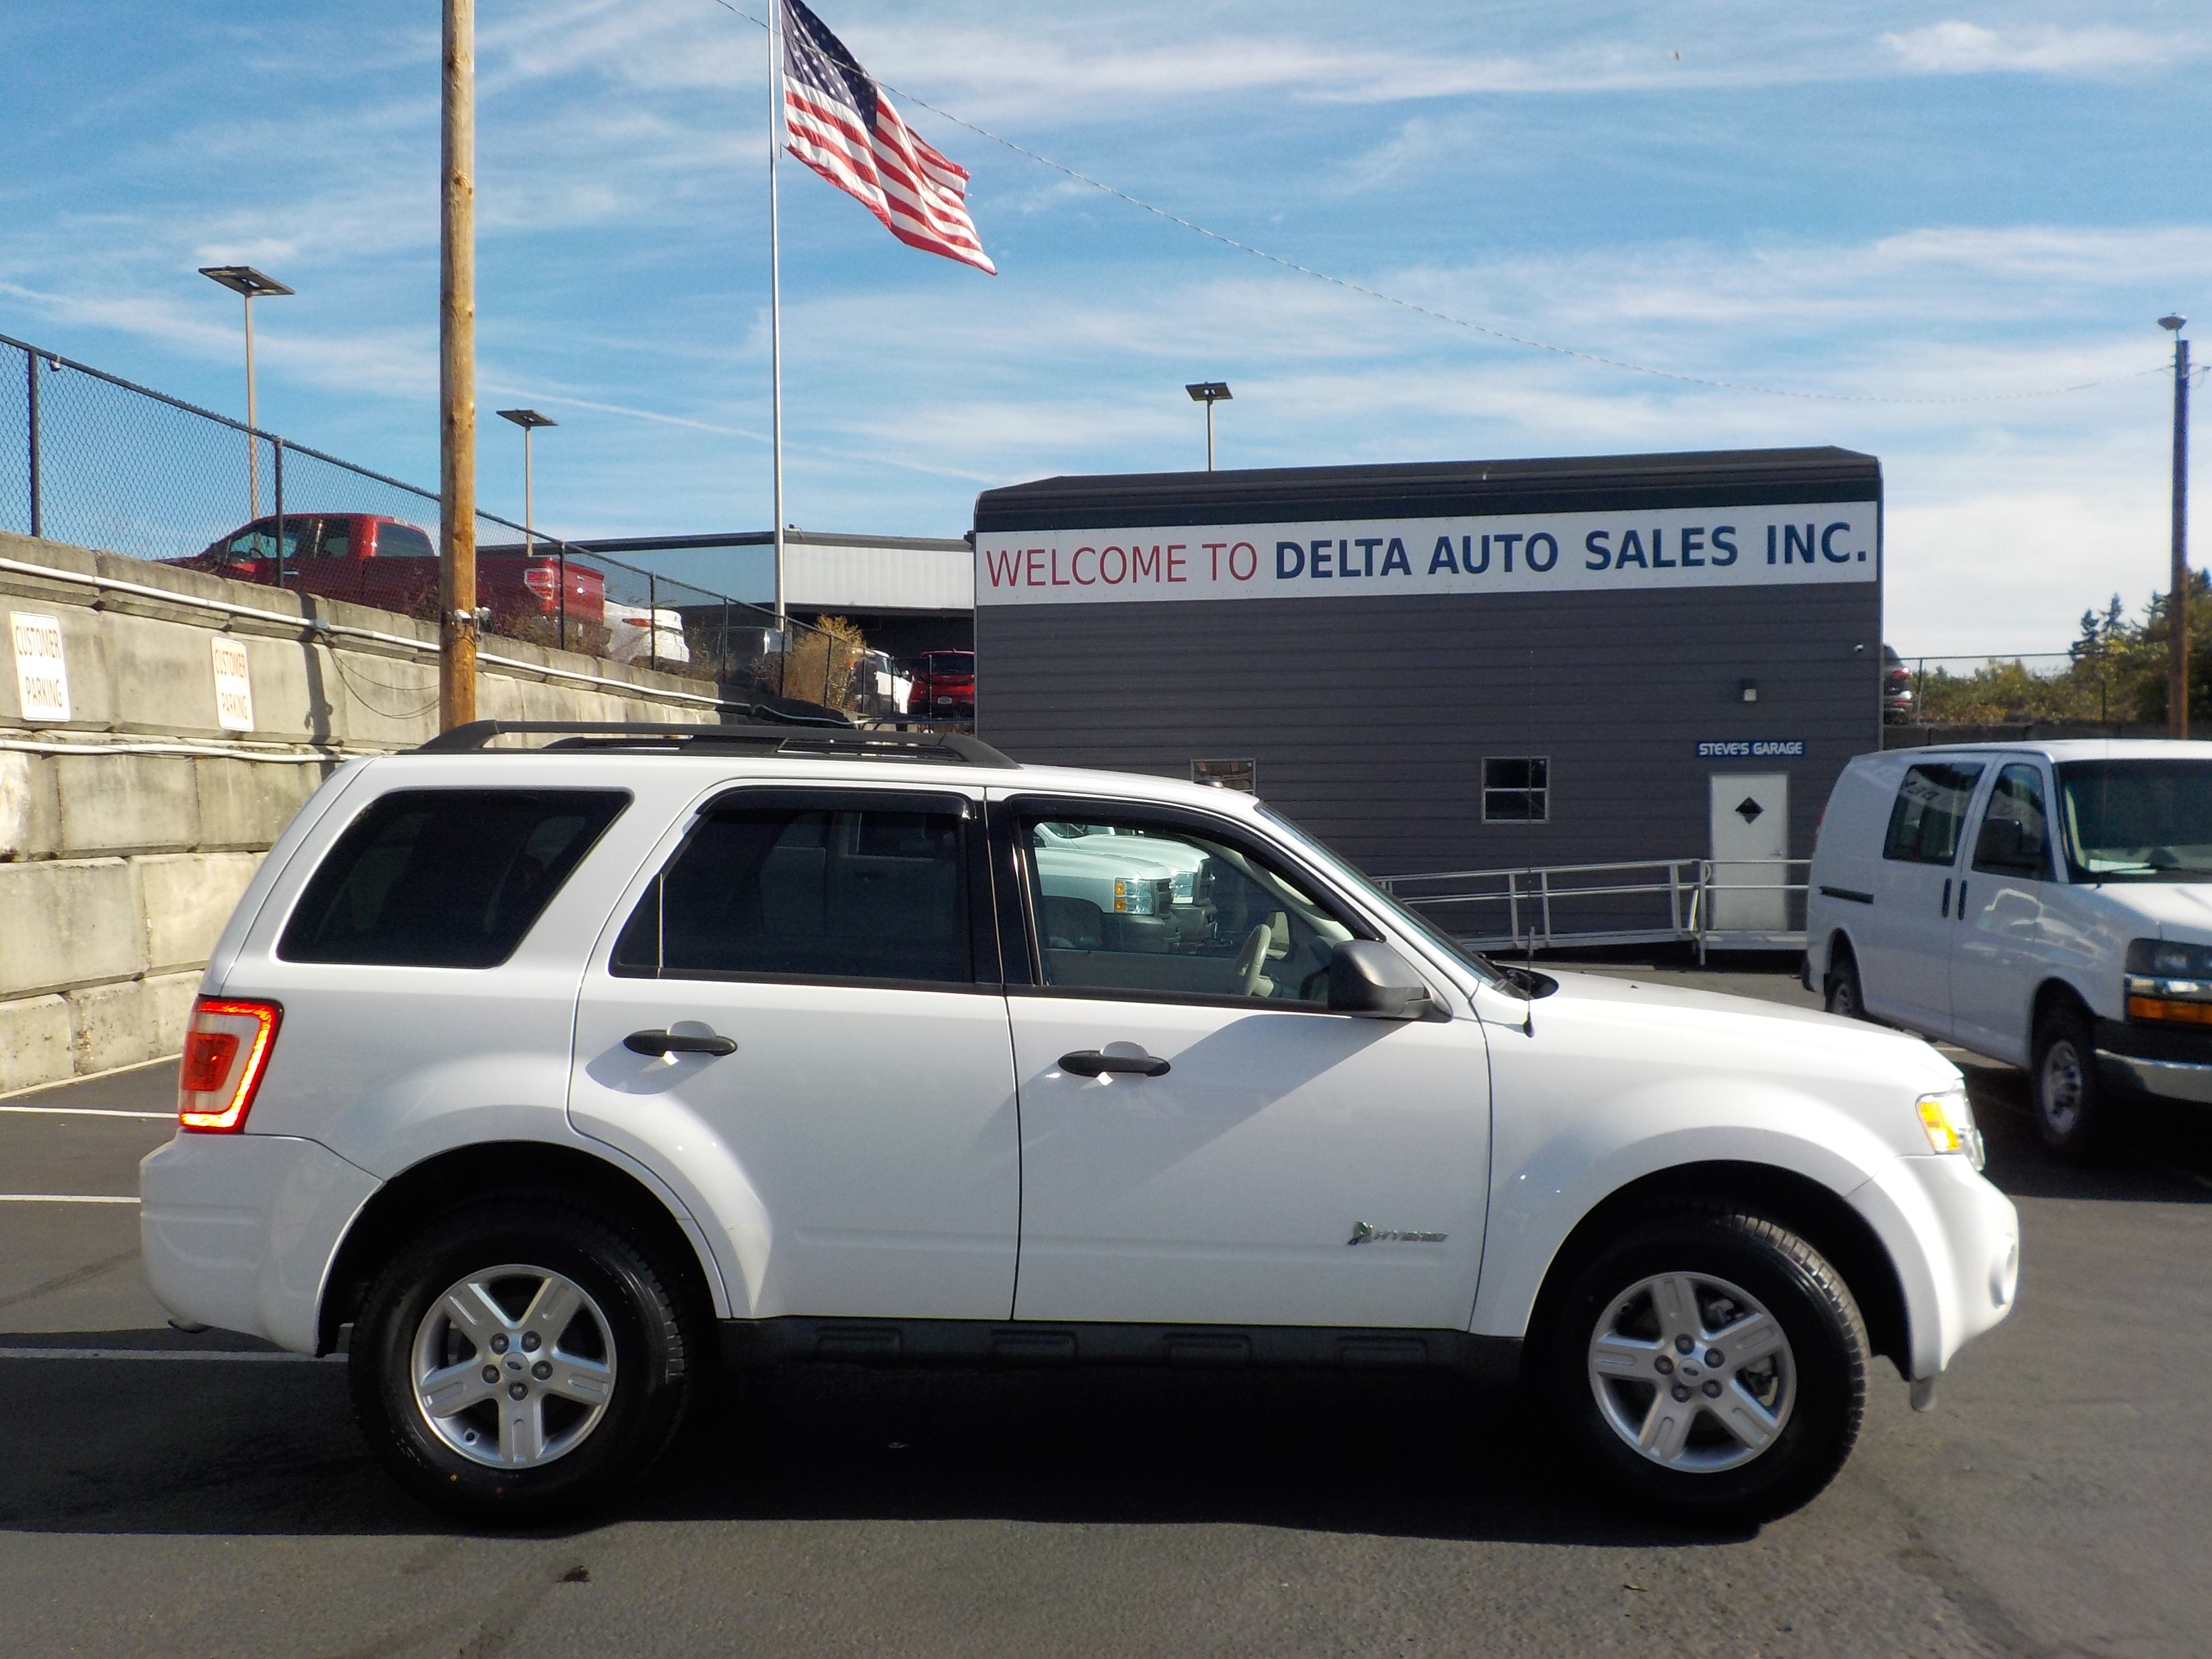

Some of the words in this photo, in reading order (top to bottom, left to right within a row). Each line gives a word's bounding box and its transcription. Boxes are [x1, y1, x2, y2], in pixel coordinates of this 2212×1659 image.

[985, 544, 1187, 587] WELCOME
[1201, 541, 1258, 581] TO
[1276, 537, 1412, 580] DELTA
[1427, 532, 1559, 575] AUTO
[1585, 525, 1739, 571] SALES
[1766, 521, 1867, 565] INC.
[15, 625, 62, 659] CUSTOMER
[214, 649, 247, 679] CUSTOMER
[26, 676, 63, 708] PARKING
[221, 692, 248, 720] PARKING
[1698, 742, 1750, 756] STEVE'S
[1753, 741, 1803, 755] GARAGE
